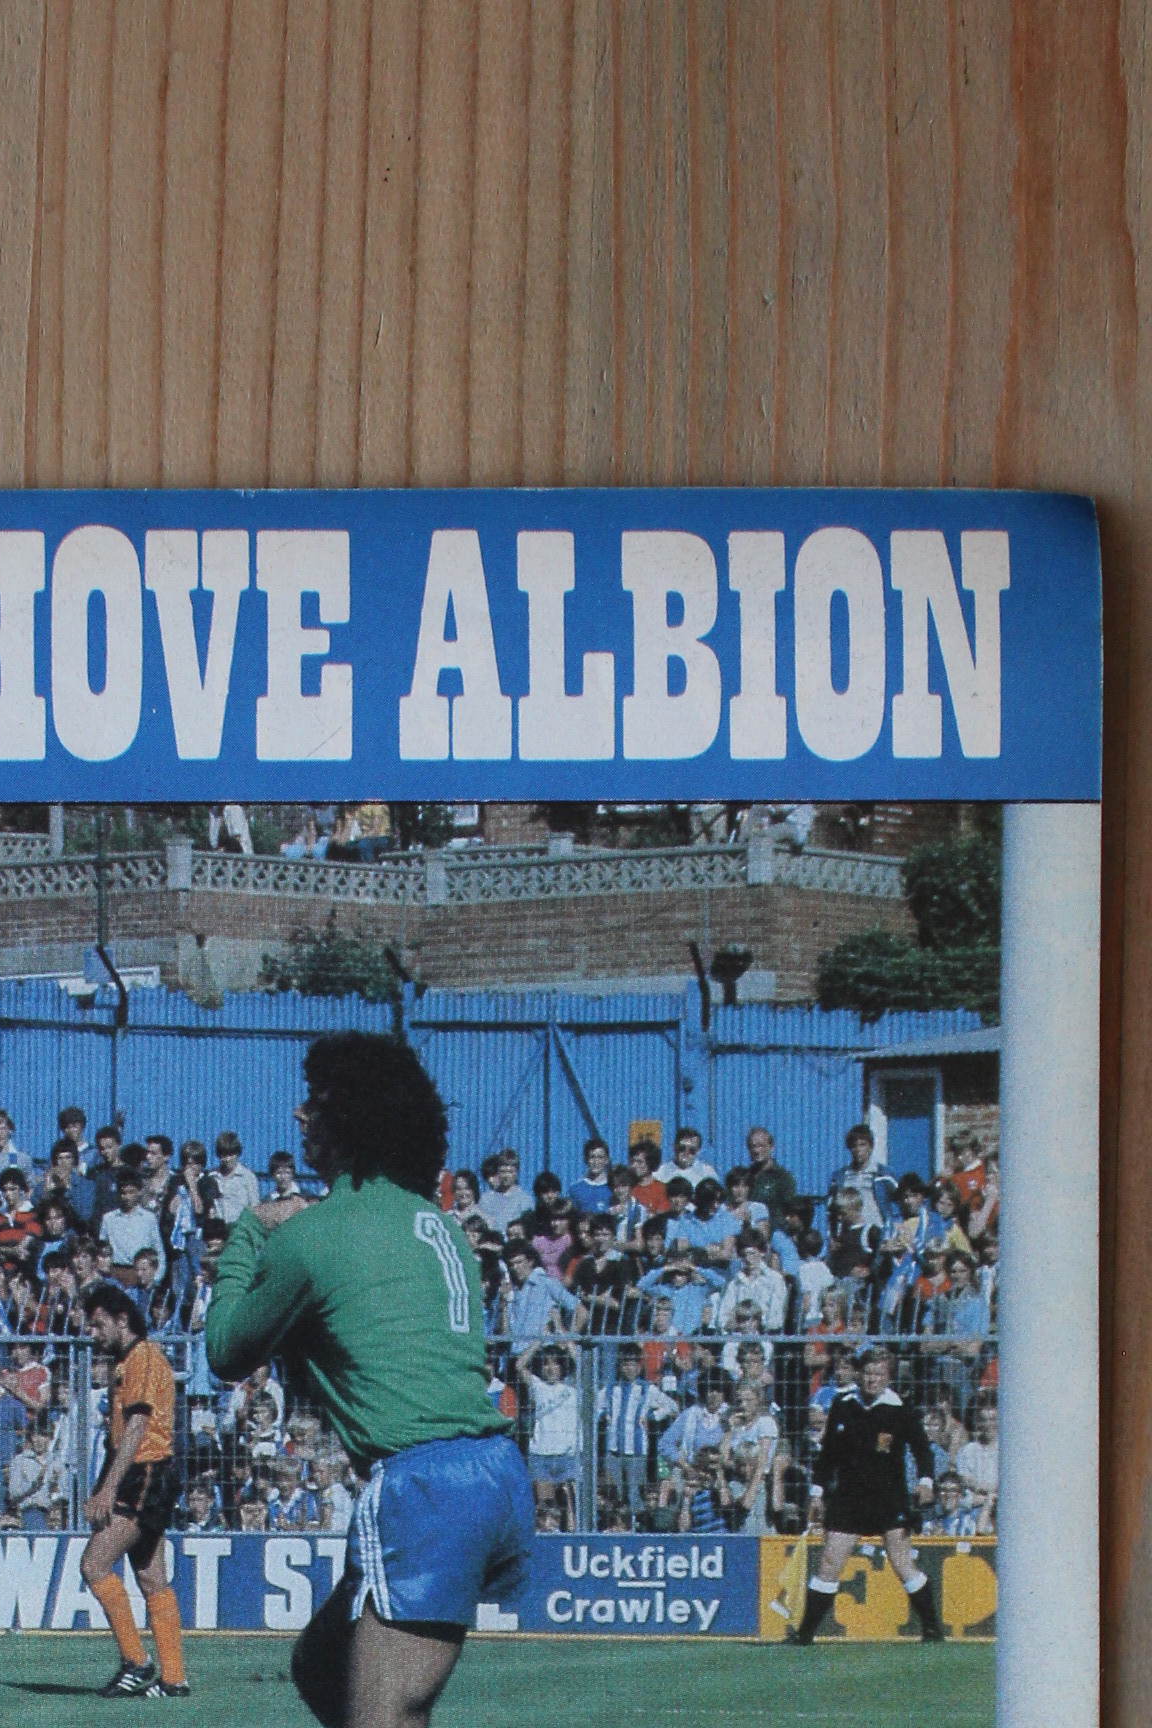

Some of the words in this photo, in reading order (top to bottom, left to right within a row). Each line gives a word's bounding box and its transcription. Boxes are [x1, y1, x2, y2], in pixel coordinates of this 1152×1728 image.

[398, 525, 1010, 764] ALBION
[414, 1211, 470, 1333] 1
[562, 1545, 724, 1580] Uckfield
[547, 1590, 721, 1631] Crawley
